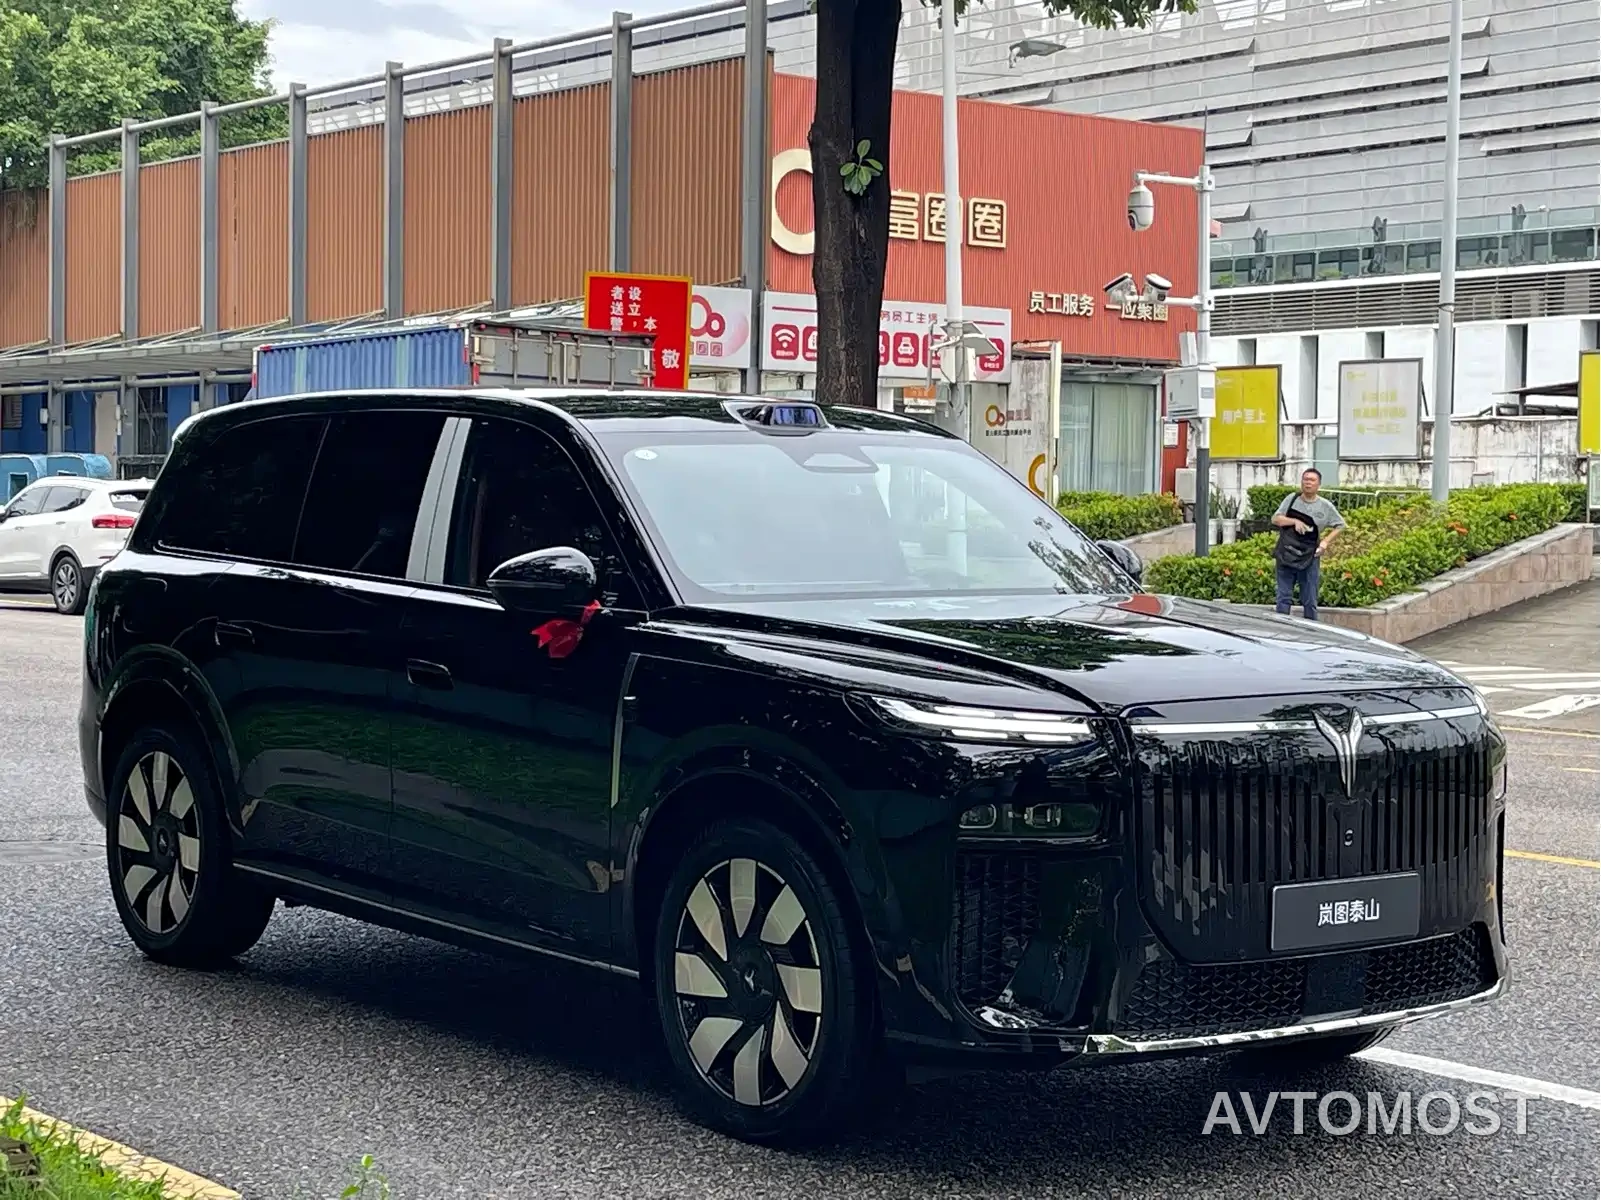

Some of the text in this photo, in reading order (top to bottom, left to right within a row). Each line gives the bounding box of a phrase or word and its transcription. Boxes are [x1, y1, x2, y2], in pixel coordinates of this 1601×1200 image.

[1029, 291, 1095, 317] 员工服务
[643, 316, 657, 332] 本
[661, 348, 680, 369] 敬
[1317, 898, 1380, 926] 岚图泰山
